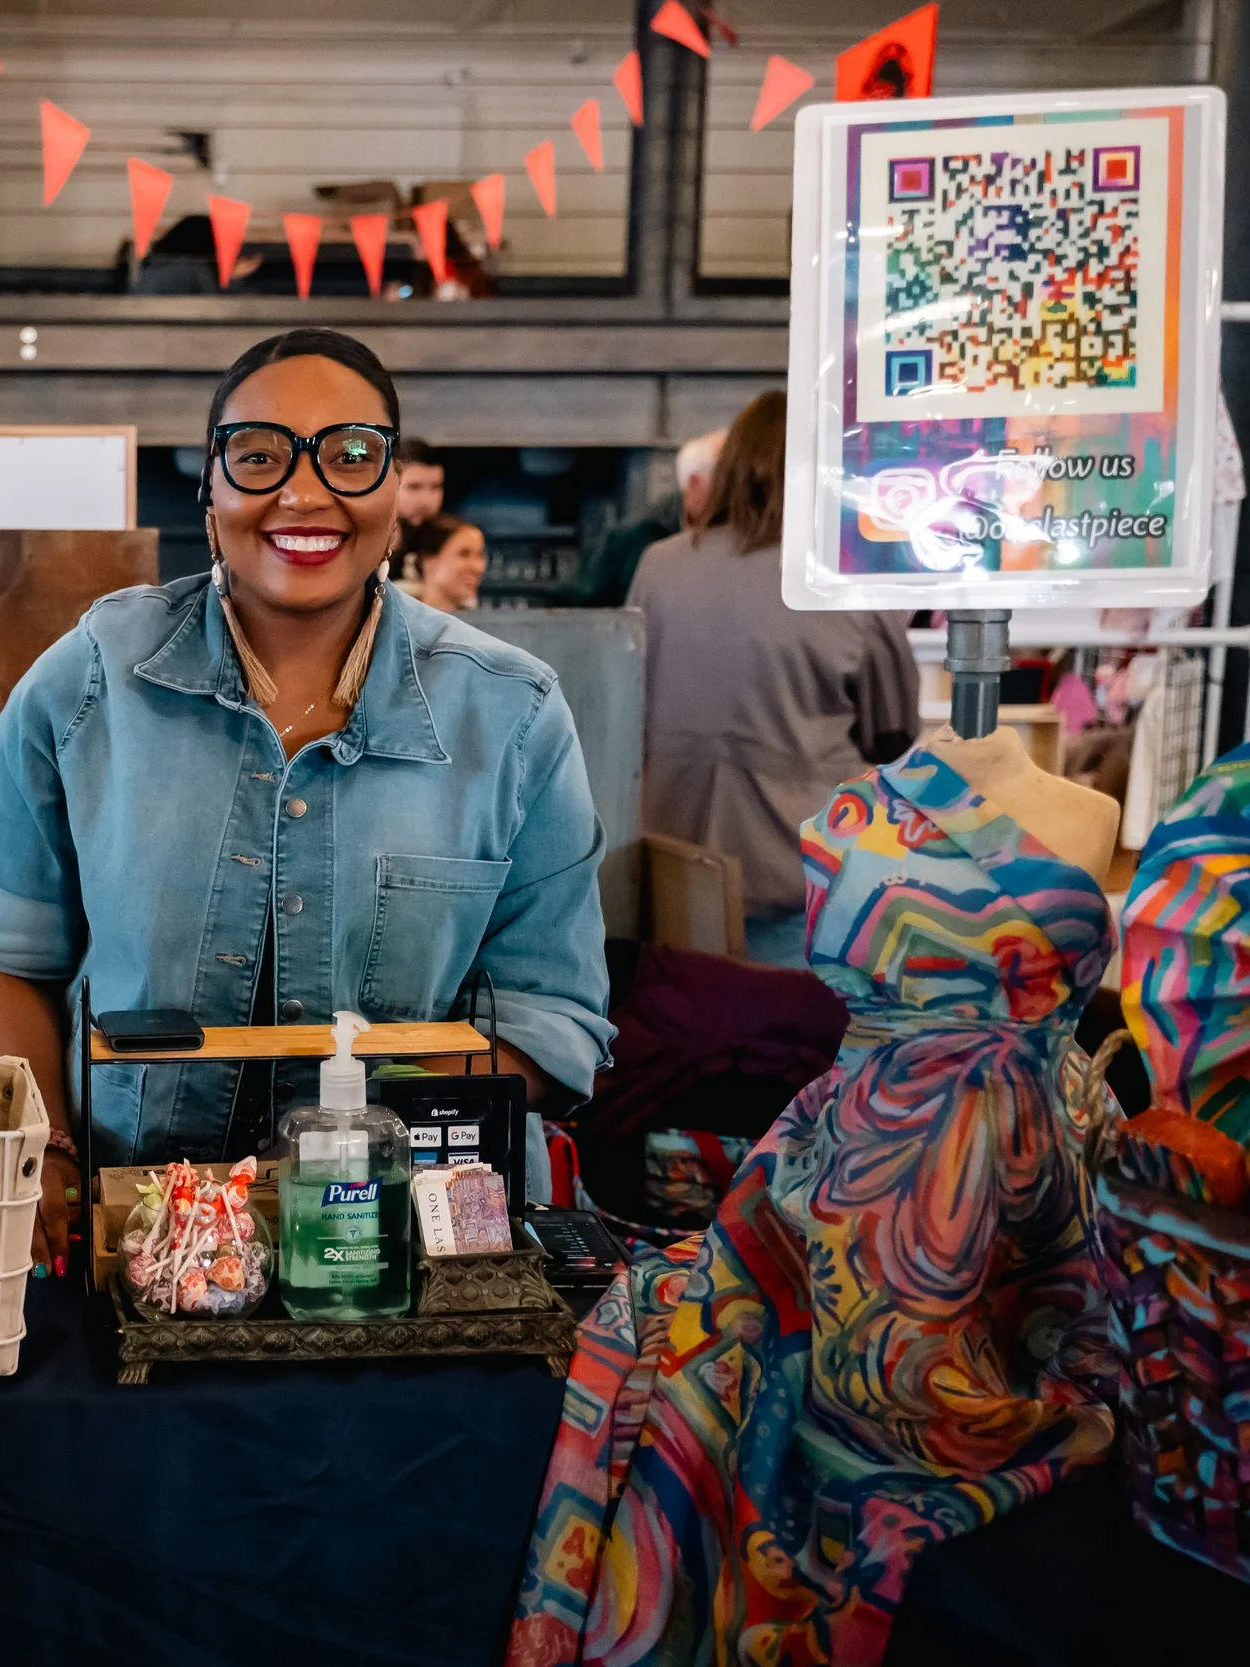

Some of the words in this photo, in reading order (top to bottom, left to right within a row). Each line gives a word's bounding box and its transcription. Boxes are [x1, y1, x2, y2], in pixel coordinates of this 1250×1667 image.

[1101, 457, 1133, 477] us
[957, 507, 1166, 548] @olastpiece
[439, 1108, 459, 1116] shopify
[422, 1133, 438, 1143] Pay
[461, 1131, 476, 1142] Pay
[329, 1183, 378, 1202] Purell
[428, 1193, 441, 1222] ONE
[321, 1213, 345, 1221] HAND
[347, 1211, 381, 1220] SANITIZE
[433, 1228, 446, 1253] LAS
[324, 1247, 345, 1261] 2X
